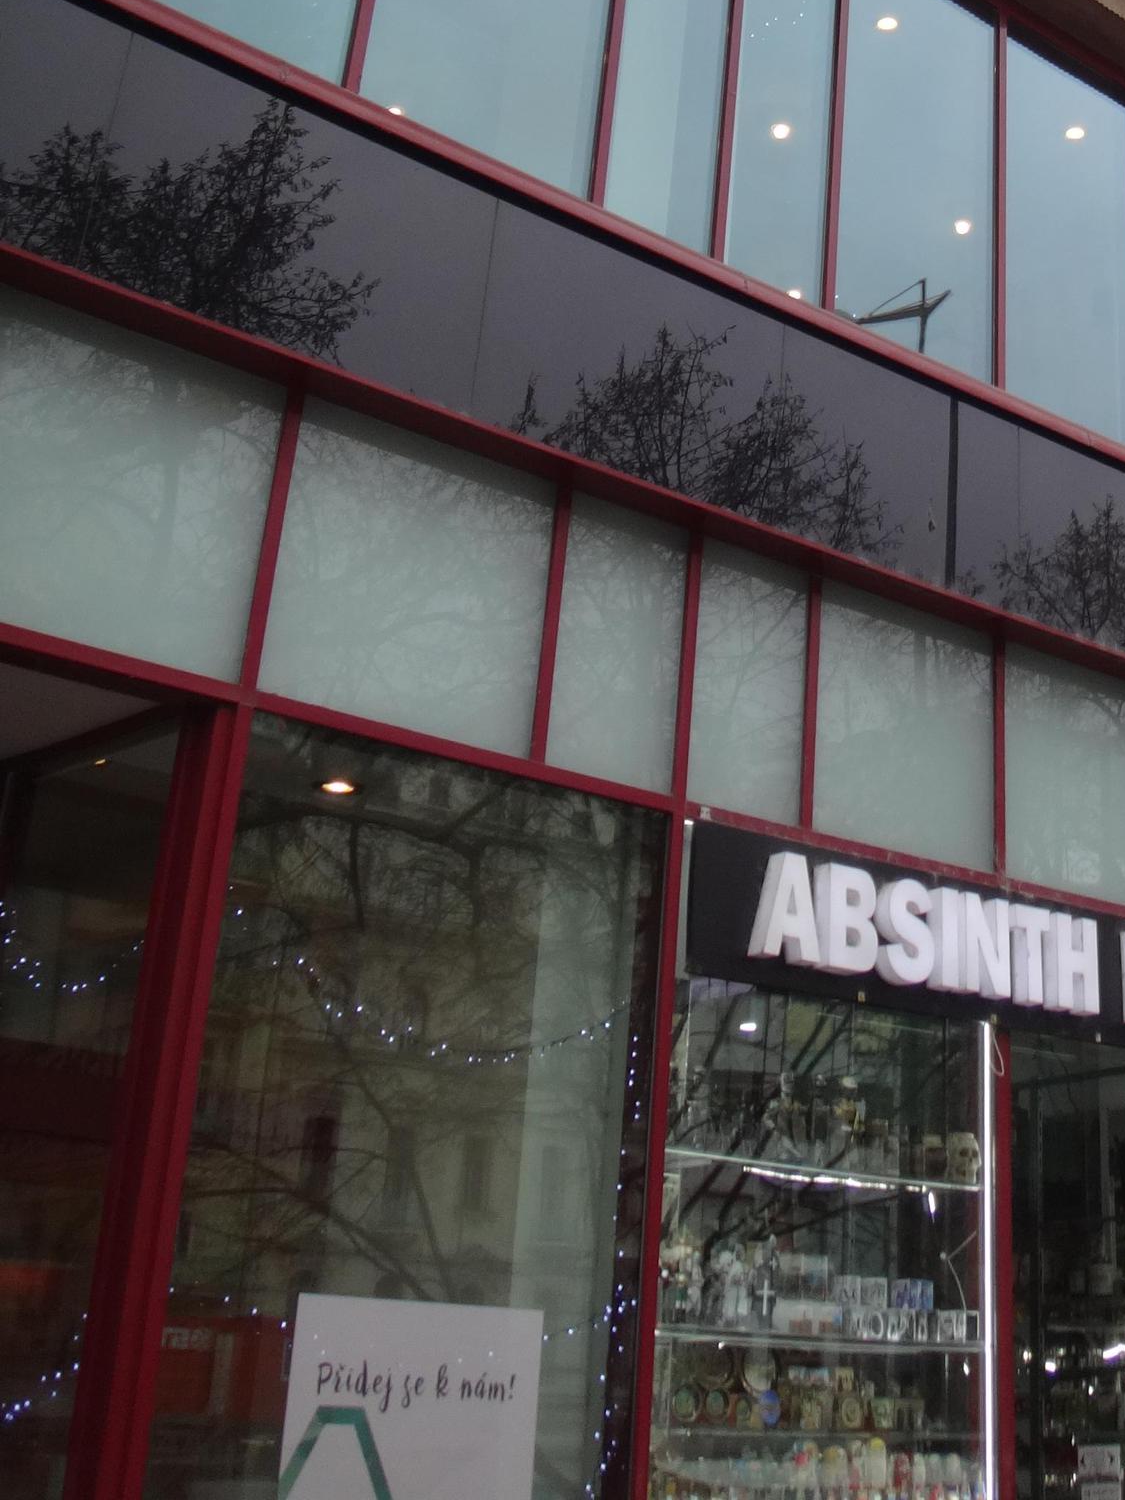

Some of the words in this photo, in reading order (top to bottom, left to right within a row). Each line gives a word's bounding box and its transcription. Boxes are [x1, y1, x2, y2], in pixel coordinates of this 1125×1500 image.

[748, 851, 1101, 1015] ABSINTH
[401, 1374, 425, 1409] se
[436, 1363, 449, 1400] k
[460, 1372, 517, 1403] nám!
